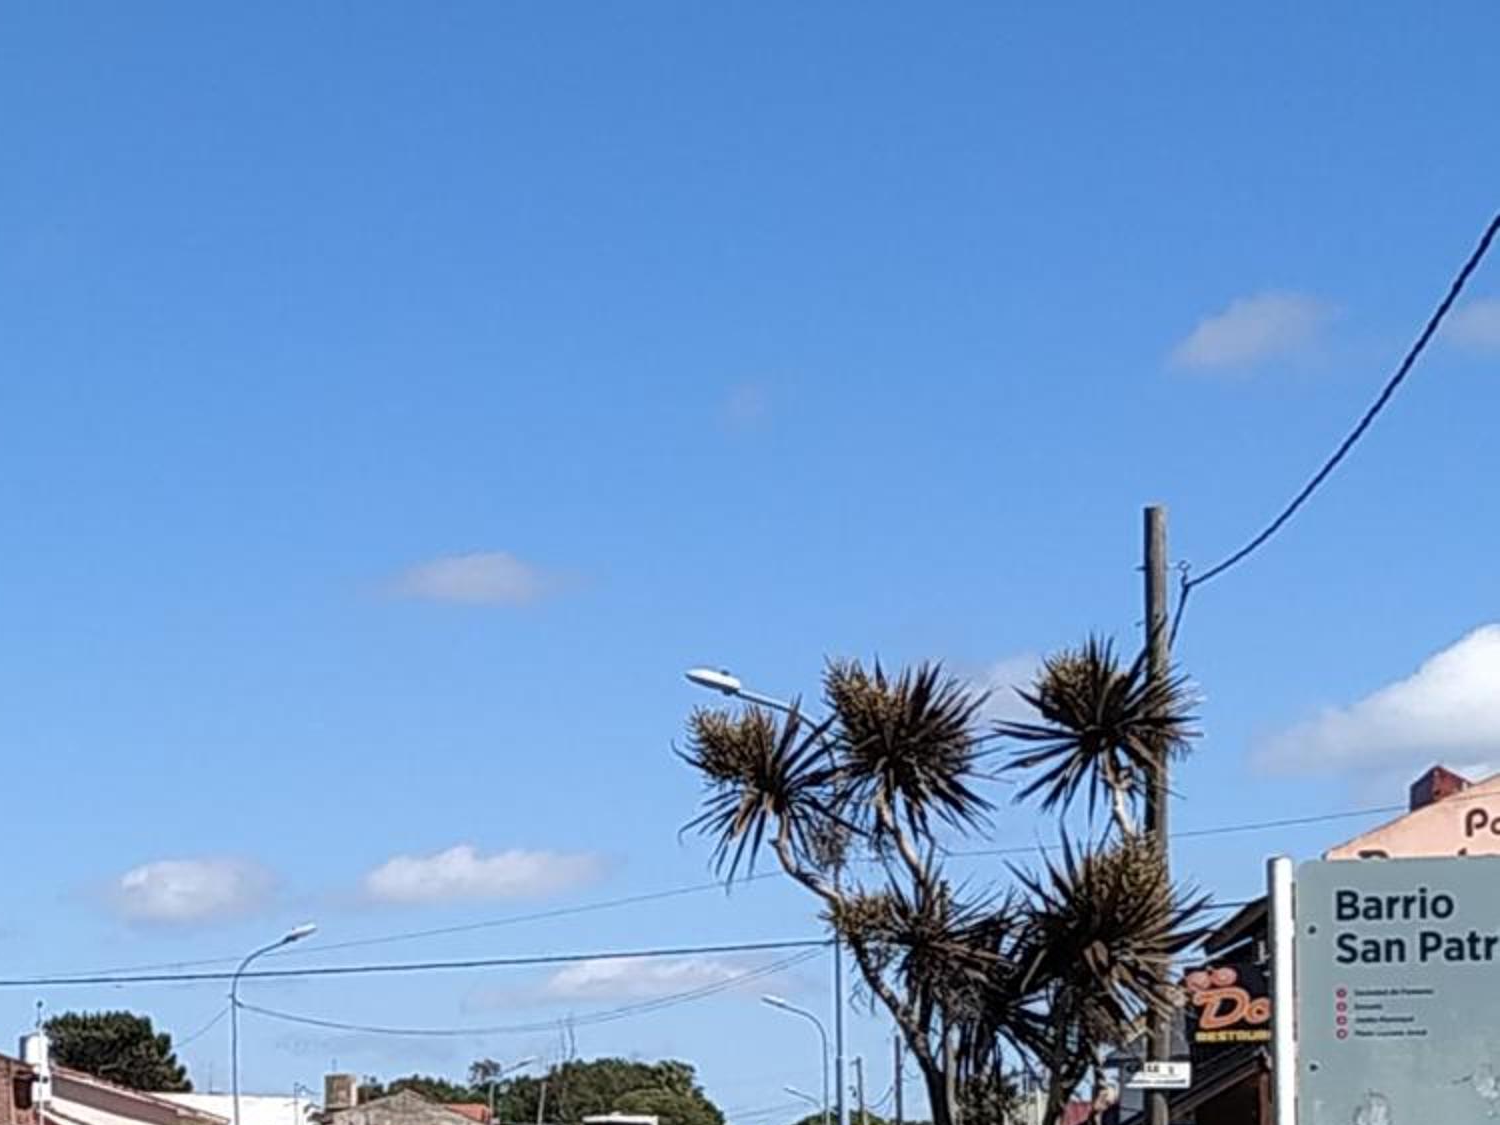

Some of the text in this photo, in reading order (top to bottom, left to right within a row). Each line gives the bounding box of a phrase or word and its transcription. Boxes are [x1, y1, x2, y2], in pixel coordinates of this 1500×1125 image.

[1336, 887, 1454, 921] Barrio
[1336, 930, 1500, 964] San Patr
